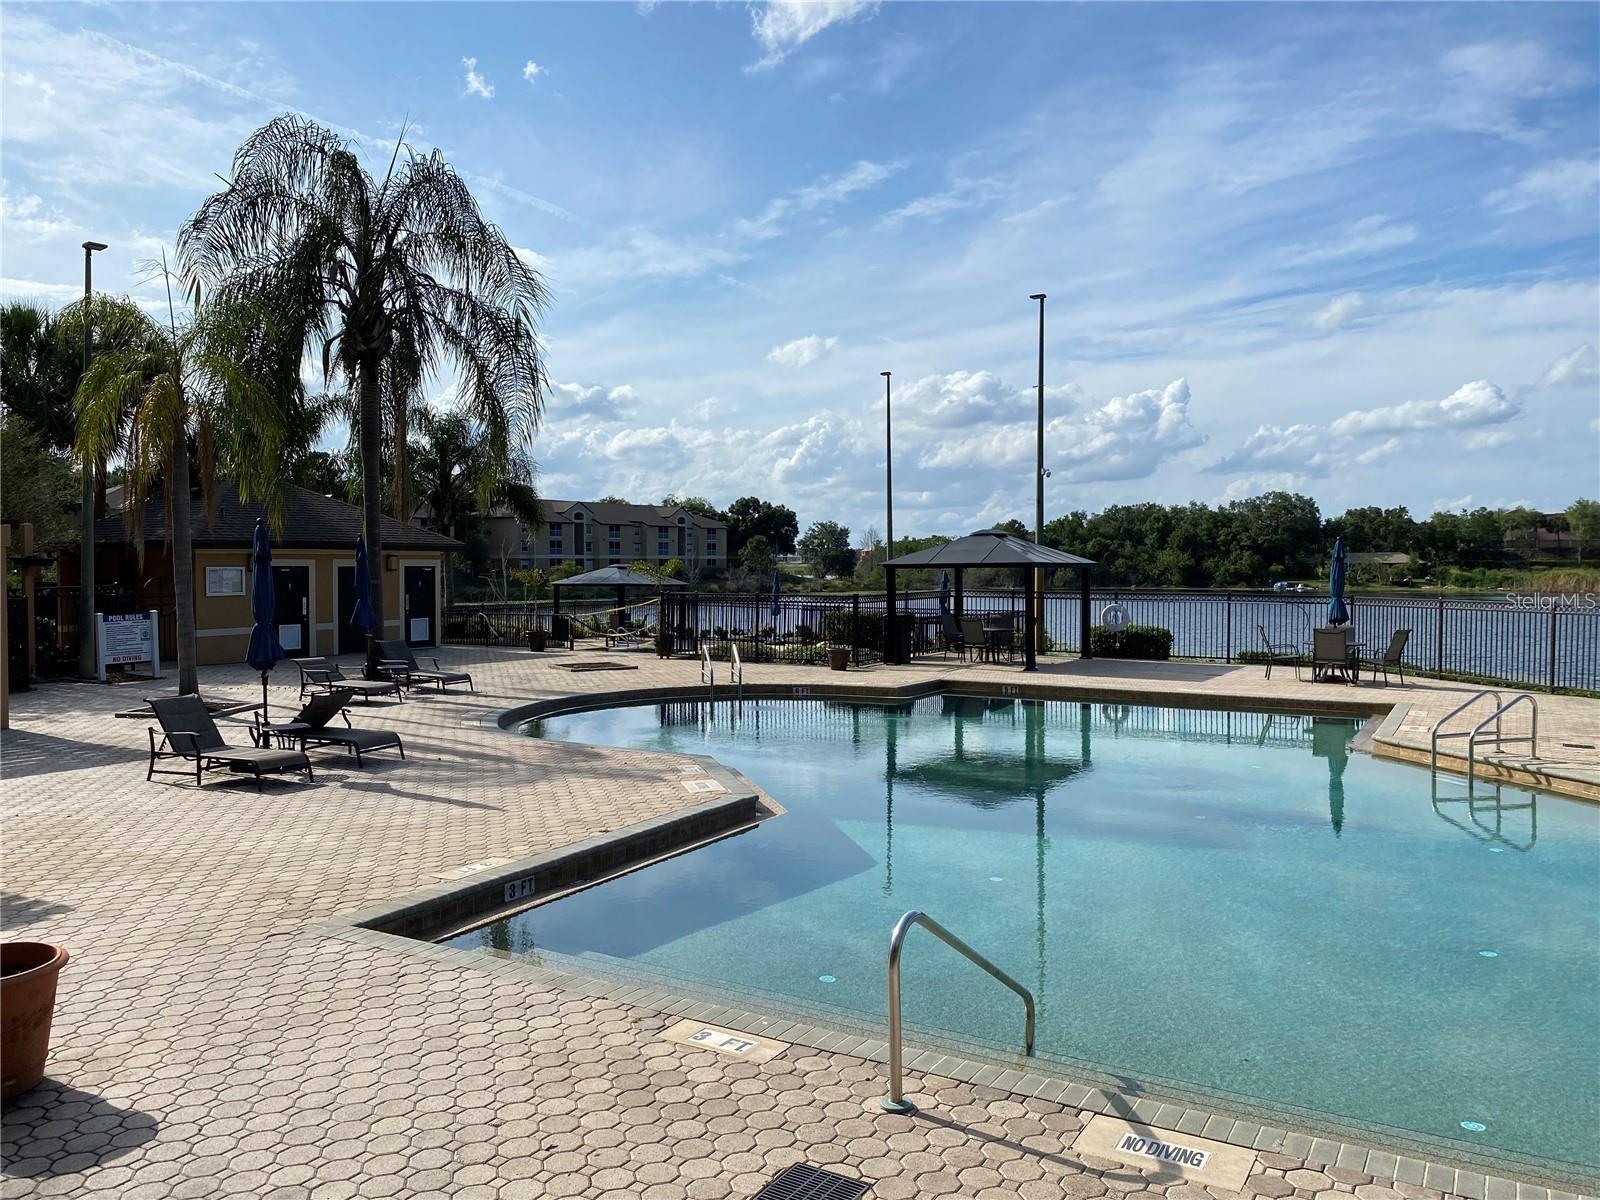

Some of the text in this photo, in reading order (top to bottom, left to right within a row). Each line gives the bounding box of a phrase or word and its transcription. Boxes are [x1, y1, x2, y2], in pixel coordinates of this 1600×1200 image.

[112, 655, 121, 663] NO
[509, 883, 516, 898] 3
[692, 1031, 713, 1041] 3
[1121, 1135, 1204, 1168] NO DIVING
